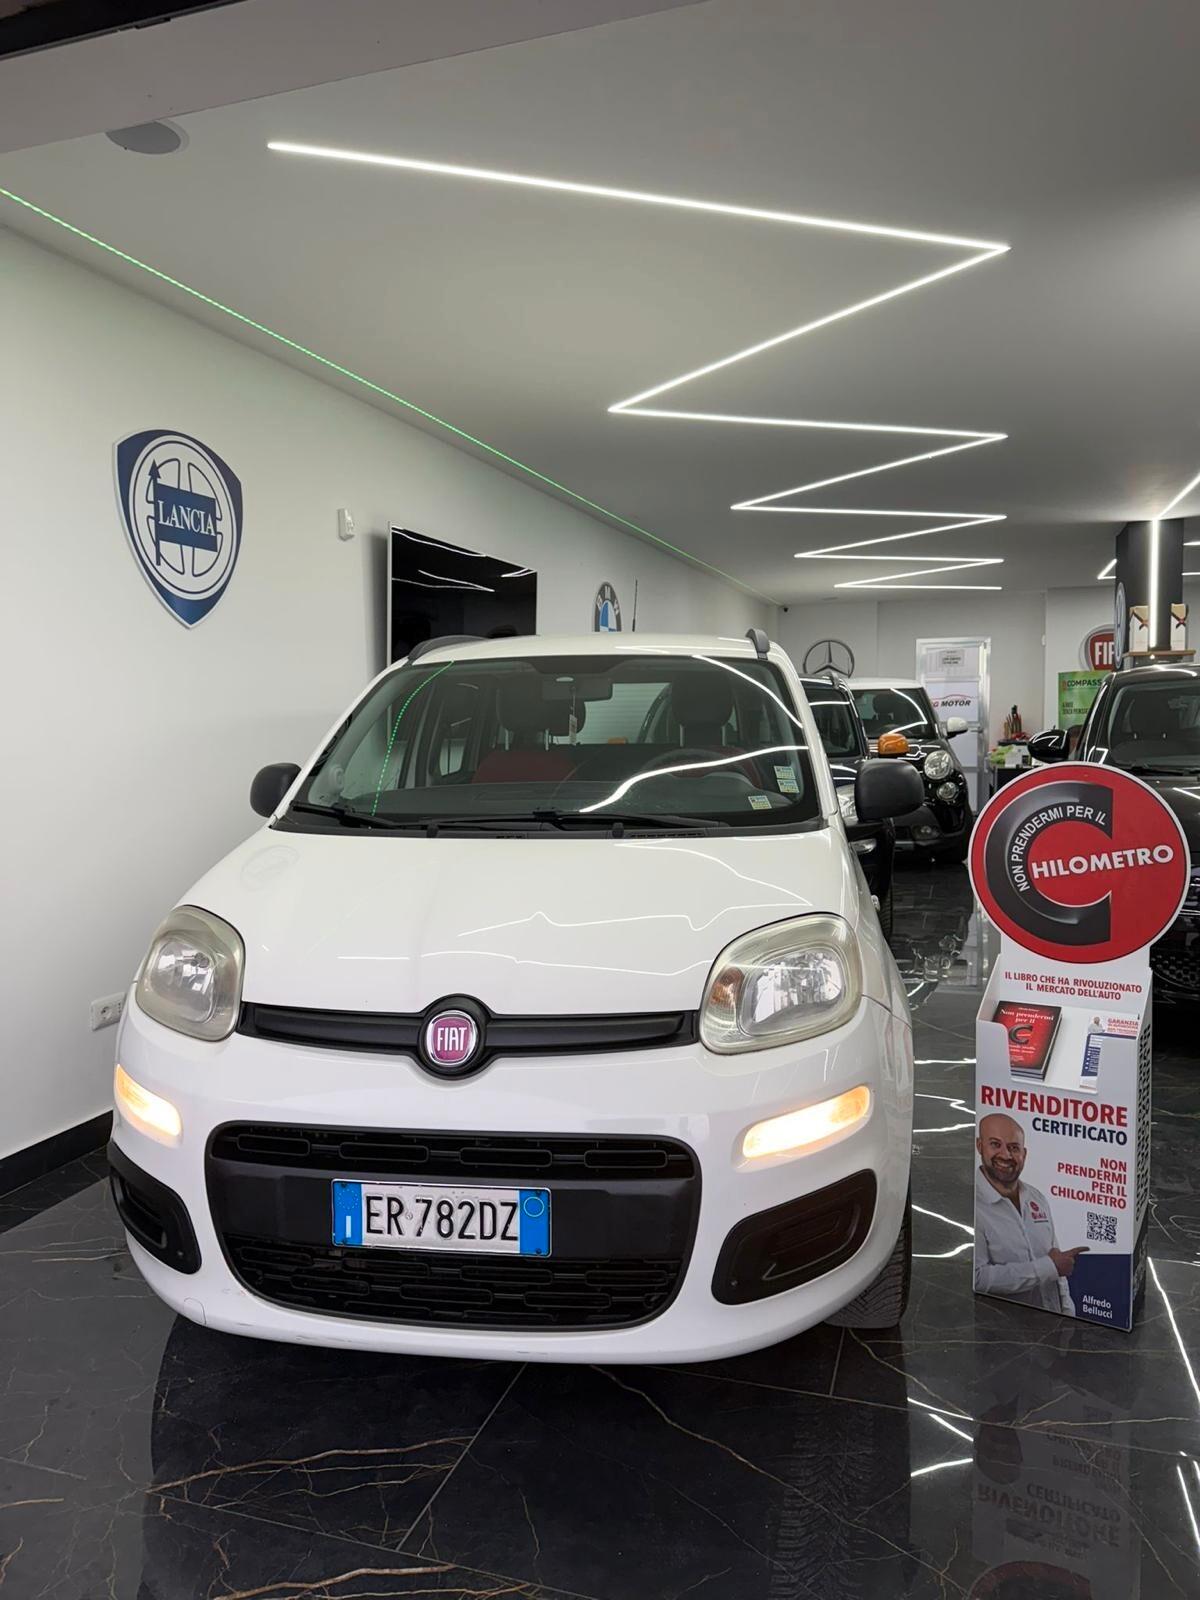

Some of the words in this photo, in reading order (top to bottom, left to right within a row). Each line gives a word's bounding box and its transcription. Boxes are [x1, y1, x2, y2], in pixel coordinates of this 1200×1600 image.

[158, 500, 216, 537] LANCIA
[940, 700, 971, 708] MOTOR
[1066, 805, 1094, 820] PER
[1095, 810, 1107, 826] IL
[1011, 806, 1064, 863] PRENDERMI
[1012, 864, 1030, 892] NON
[1004, 971, 1013, 980] IL
[1013, 972, 1038, 983] LIBRO
[1039, 975, 1056, 984] CHE
[1058, 977, 1070, 986] HA
[1073, 978, 1142, 993] RIVOLUZIONATO
[1025, 982, 1033, 991] IL
[1036, 984, 1076, 996] MERCATO
[1077, 988, 1122, 1000] DELL'AUTO
[437, 1027, 467, 1052] FIAT
[981, 1085, 1128, 1128] RIVENDITORE
[1032, 1117, 1128, 1146] CERTIFICATO
[1057, 1162, 1127, 1185] PRENDERMI
[1100, 1157, 1127, 1172] NON
[1050, 1185, 1127, 1210] CHILOMETRO
[1091, 1181, 1113, 1195] PER
[1116, 1186, 1127, 1198] IL
[365, 1195, 404, 1236] ER
[415, 1197, 518, 1241] 782DZ
[1082, 1295, 1112, 1309] Alfredo
[1082, 1304, 1113, 1320] Bellucci
